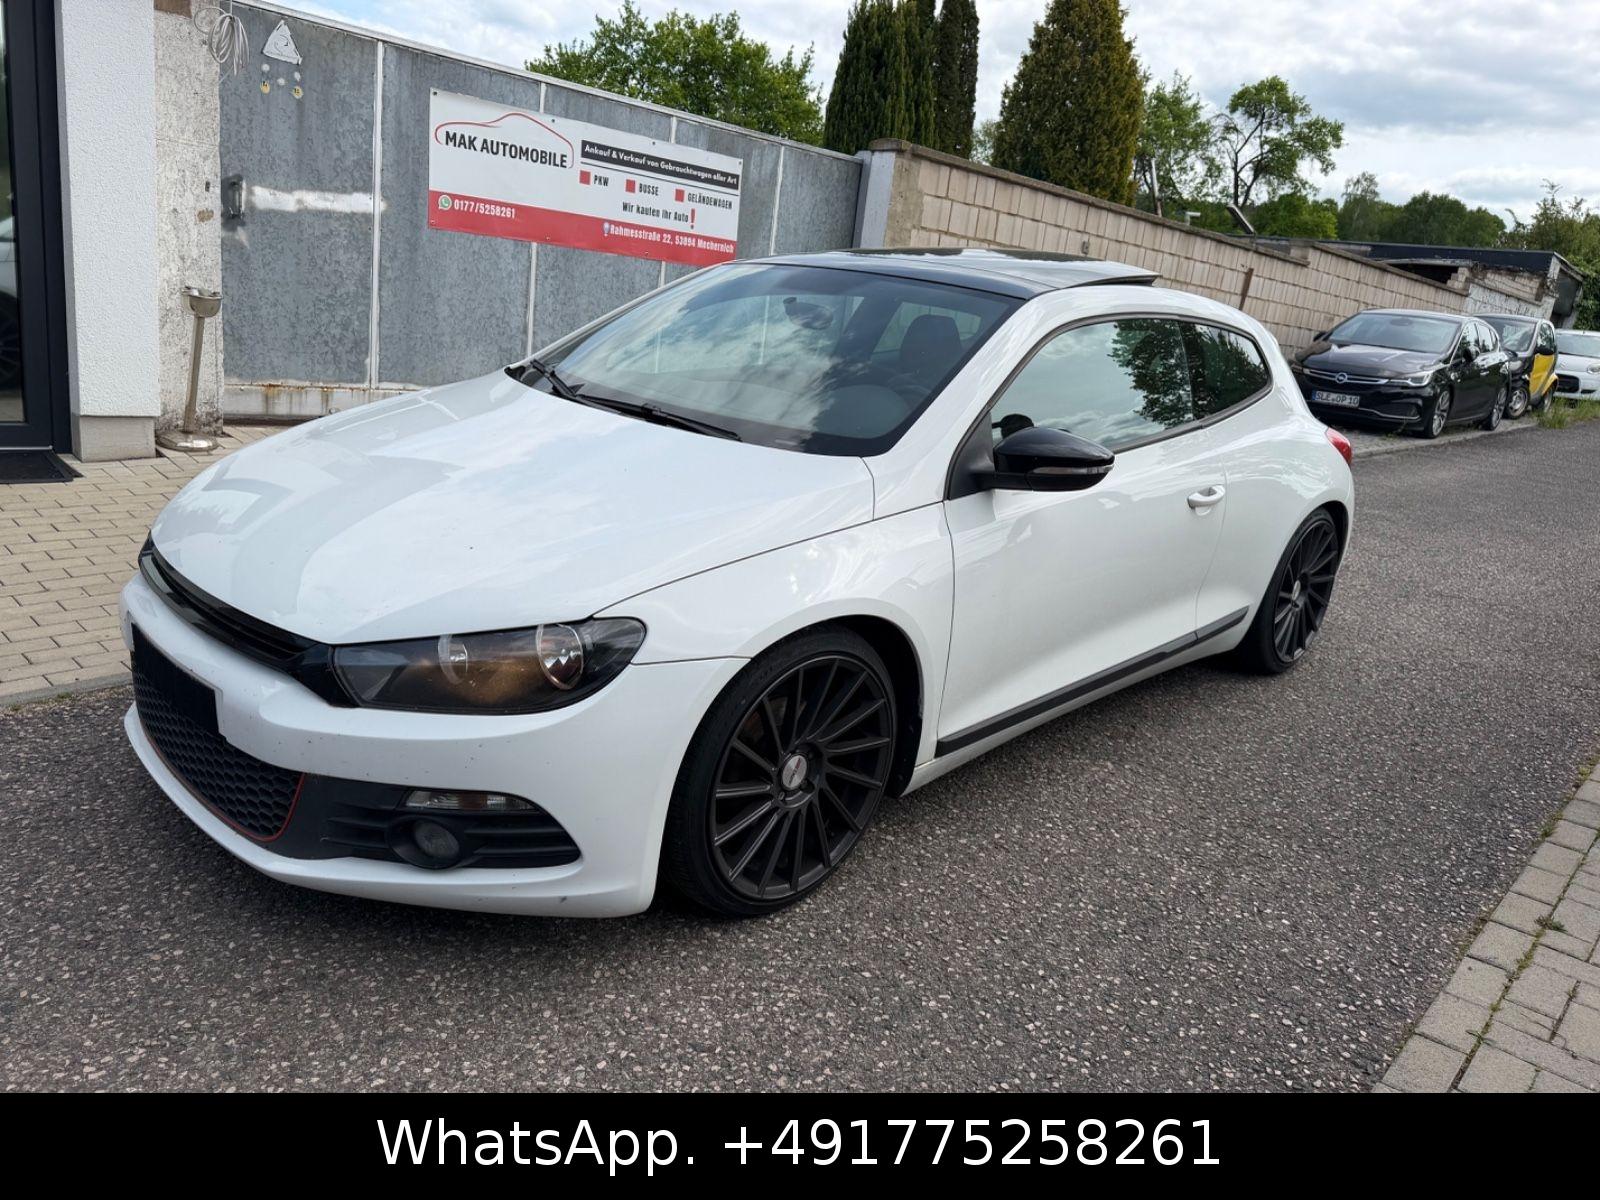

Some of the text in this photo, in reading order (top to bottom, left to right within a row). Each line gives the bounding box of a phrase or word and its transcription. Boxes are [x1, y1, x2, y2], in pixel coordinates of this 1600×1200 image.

[445, 130, 568, 169] MAK AUTOMOBILE
[584, 144, 611, 157] Ankauf
[611, 150, 618, 159] &
[619, 152, 646, 165] Verkauf
[647, 160, 660, 168] von
[660, 161, 713, 179] Gebrauchtwagen
[727, 175, 738, 185] Art
[593, 174, 609, 187] PKW
[639, 182, 659, 196] BUSSE
[454, 198, 516, 219] 0177/5258261
[622, 201, 634, 213] Wir
